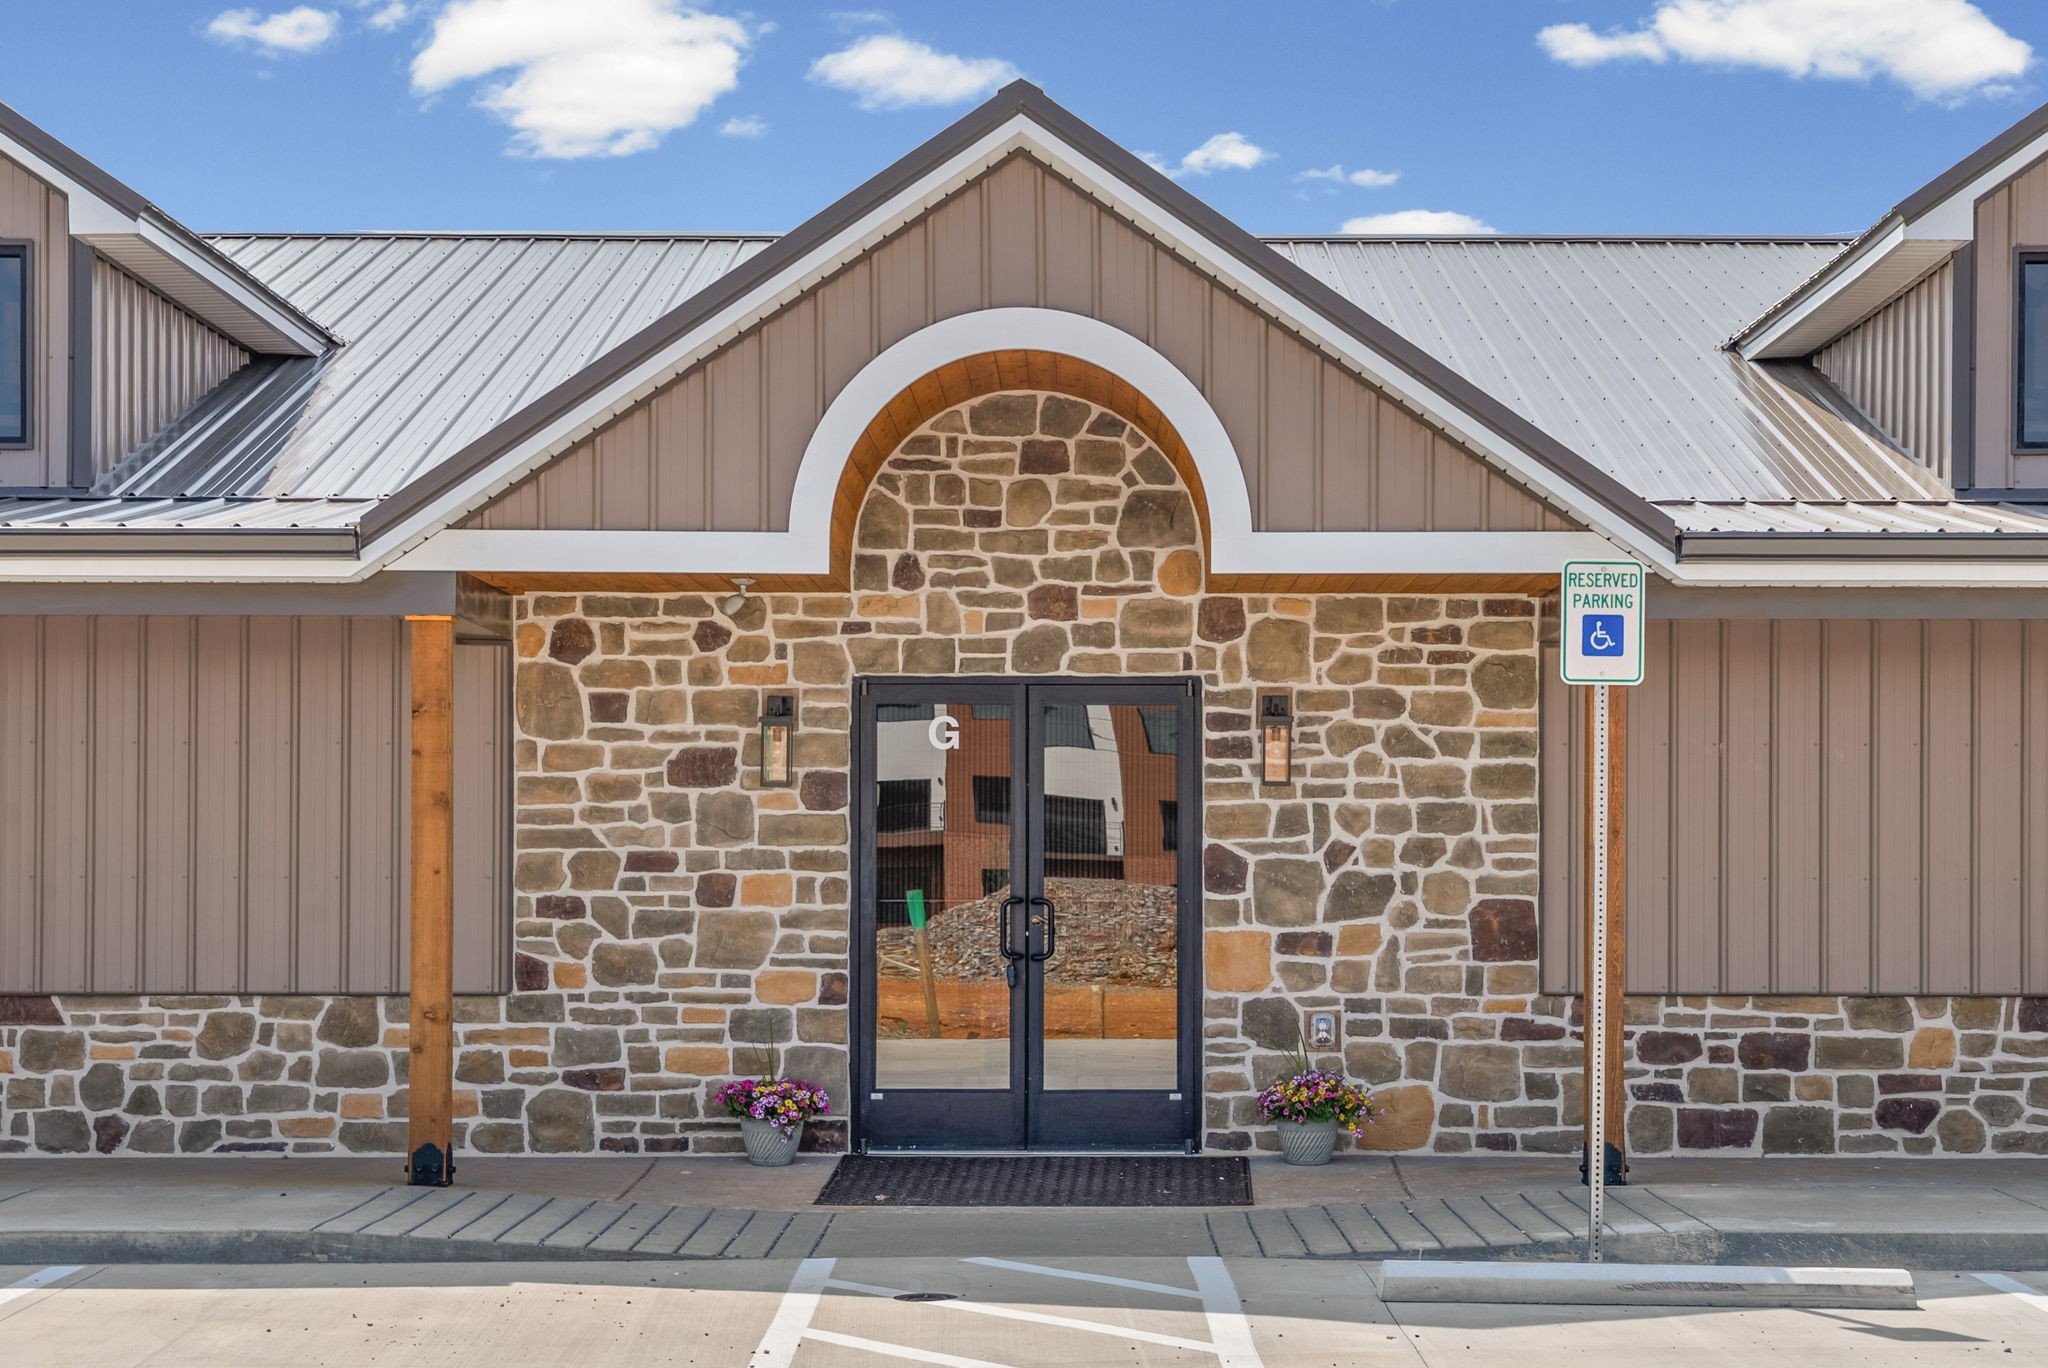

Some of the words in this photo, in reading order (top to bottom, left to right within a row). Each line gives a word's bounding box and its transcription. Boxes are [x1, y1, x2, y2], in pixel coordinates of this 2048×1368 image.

[1568, 572, 1639, 588] RESERVED
[1573, 593, 1634, 609] PARKING
[928, 715, 960, 751] G
